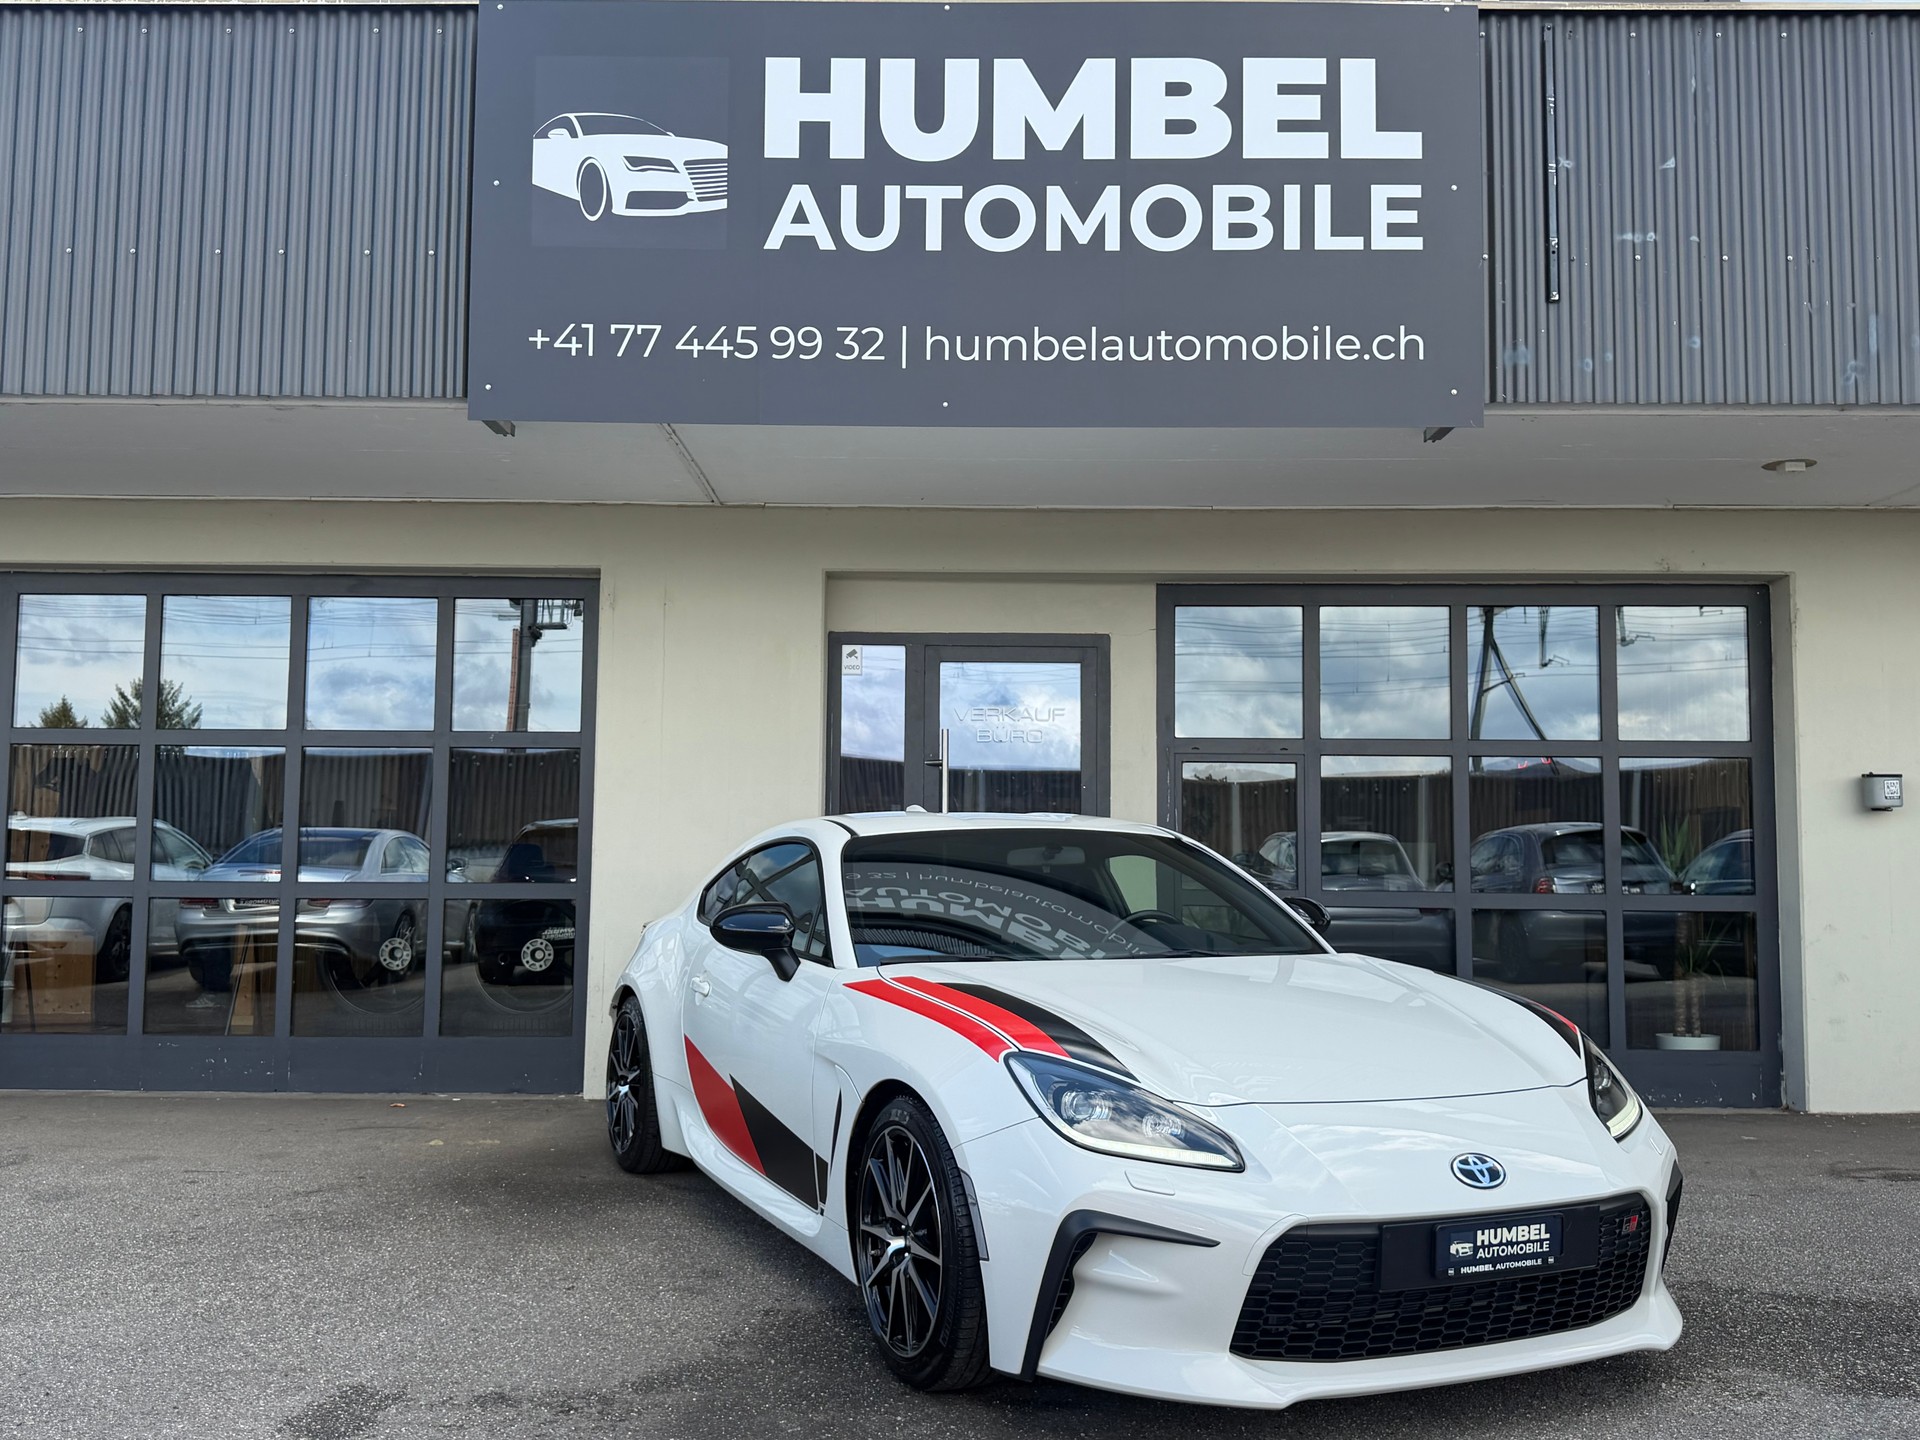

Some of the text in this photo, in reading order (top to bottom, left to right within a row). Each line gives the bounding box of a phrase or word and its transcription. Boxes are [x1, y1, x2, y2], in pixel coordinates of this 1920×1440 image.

[763, 57, 1423, 162] HUMBEL
[763, 184, 1424, 253] AUTOMOBILE
[528, 323, 594, 357] +41
[610, 324, 662, 357] 77
[675, 325, 759, 360] 445
[769, 325, 823, 360] 99
[835, 326, 885, 361] 32
[926, 325, 1424, 362] humbelautomobile.ch
[953, 706, 1066, 722] VERKAUF
[975, 725, 1043, 744] BÜRO
[1476, 1223, 1550, 1246] HUMBEL
[1476, 1241, 1550, 1259] AUTOMOBILE
[1460, 1258, 1542, 1274] HUMBEL AUTOMOBILE
